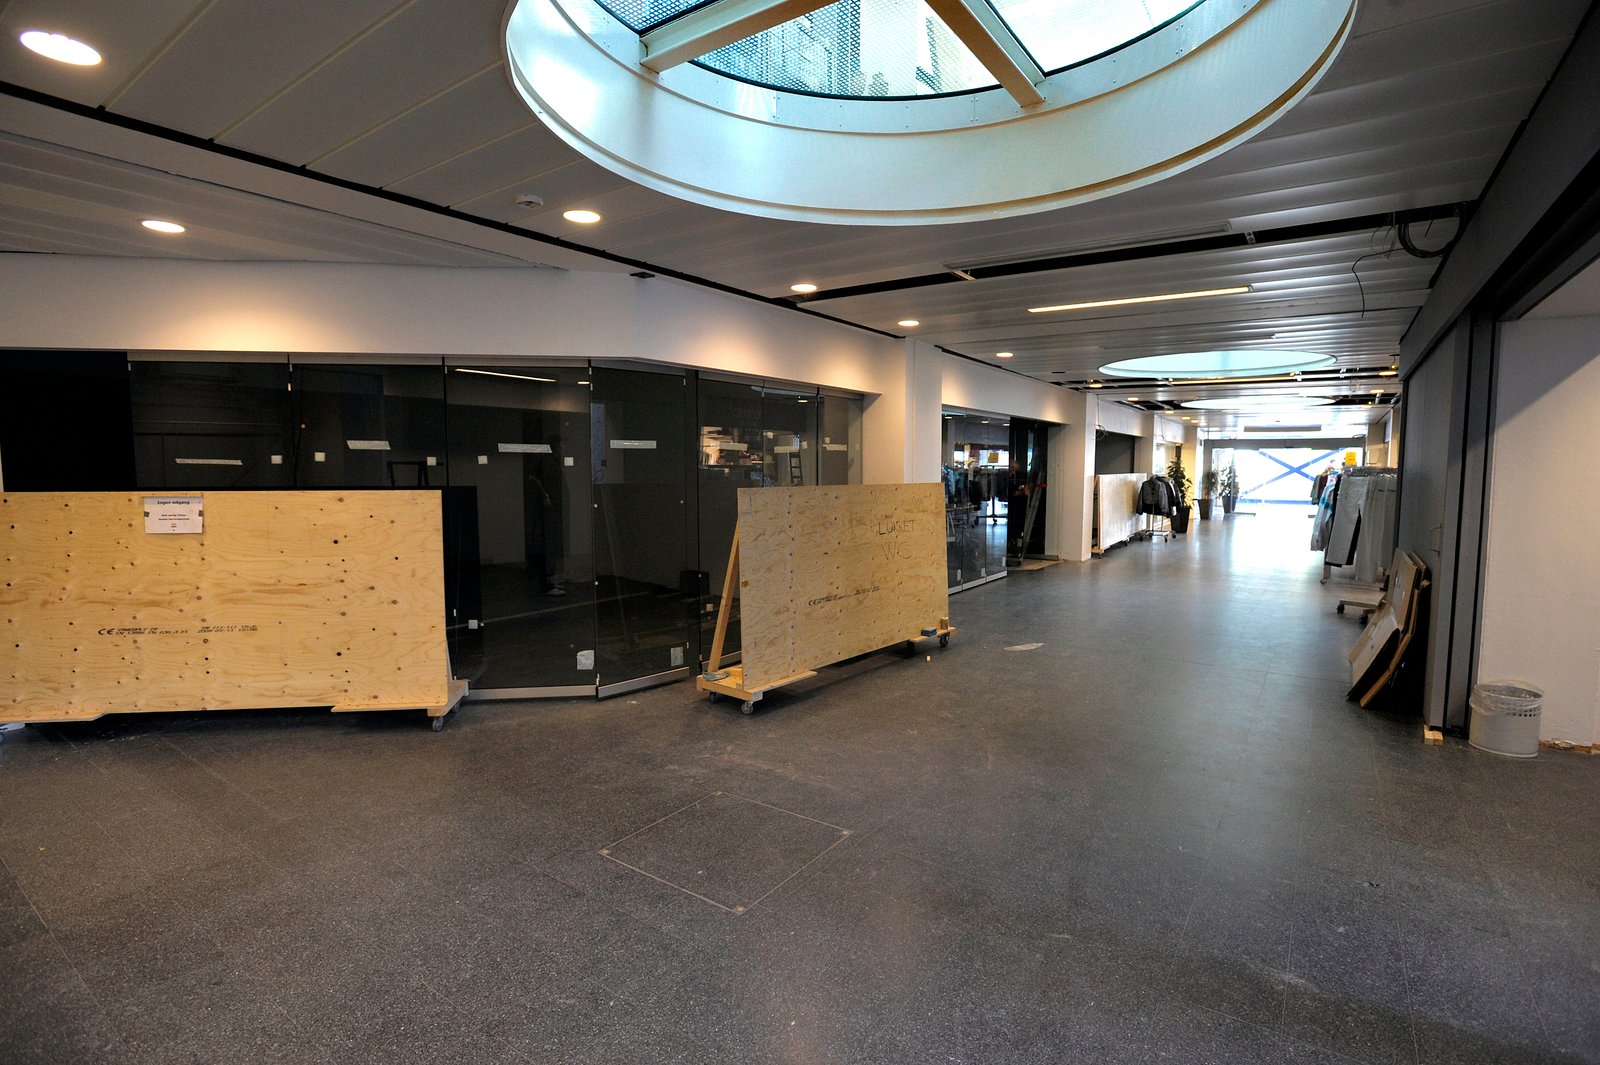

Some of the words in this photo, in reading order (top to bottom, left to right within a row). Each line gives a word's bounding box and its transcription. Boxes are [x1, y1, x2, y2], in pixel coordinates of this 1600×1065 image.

[878, 519, 916, 536] LUKKET
[880, 541, 913, 560] WC
[97, 628, 115, 636] CE
